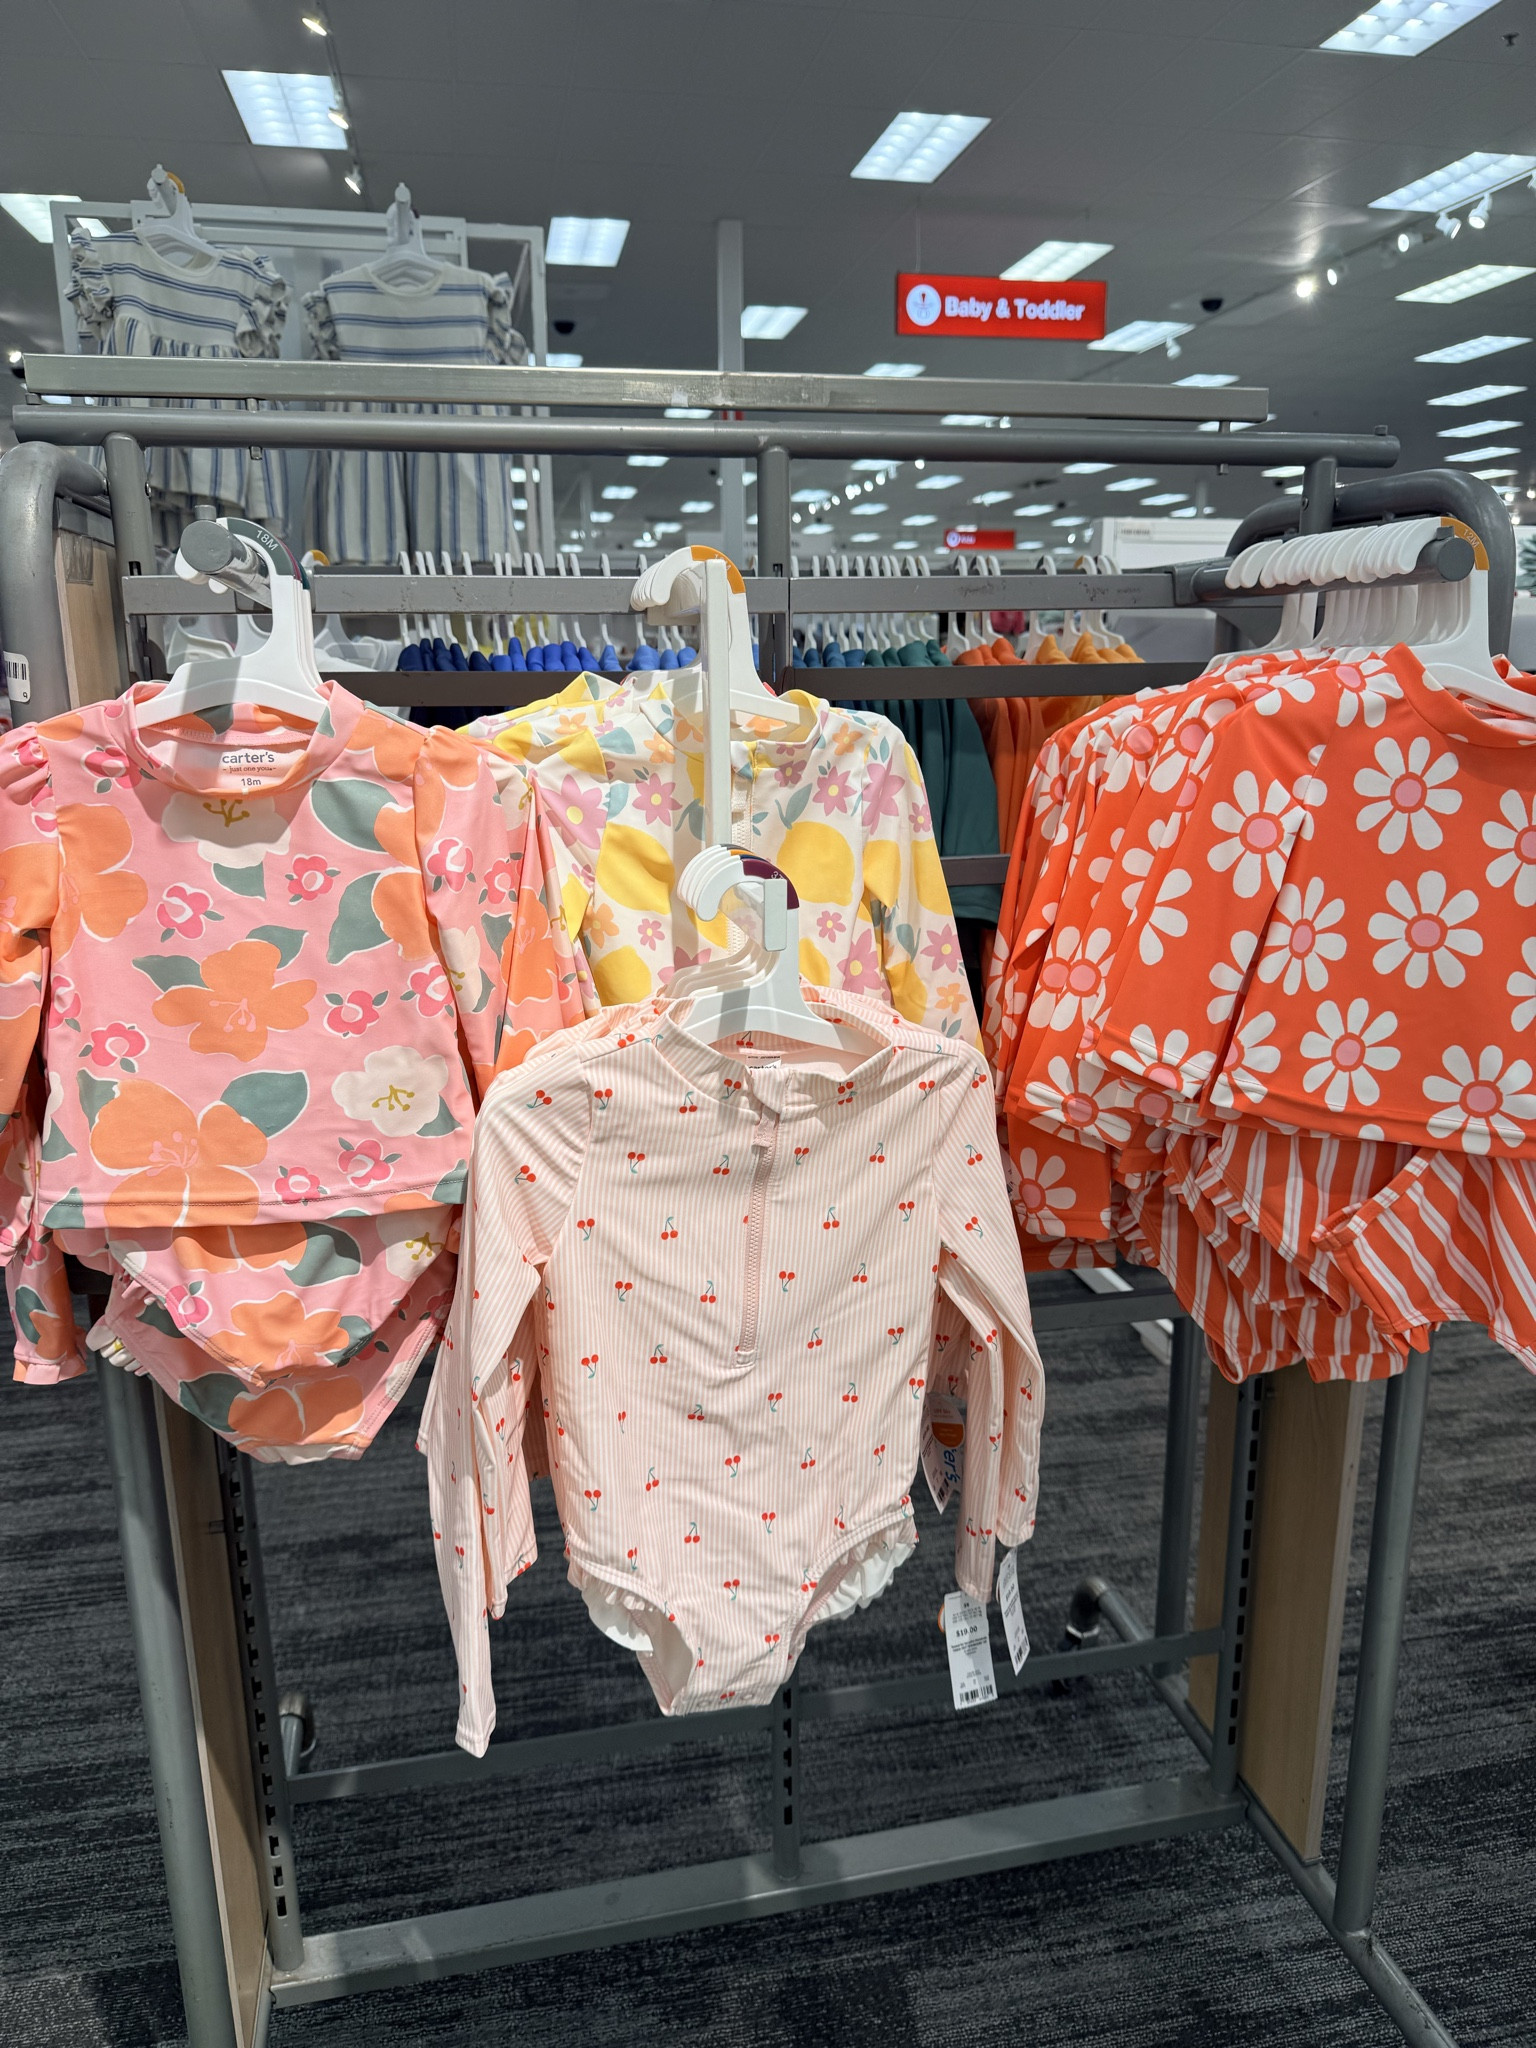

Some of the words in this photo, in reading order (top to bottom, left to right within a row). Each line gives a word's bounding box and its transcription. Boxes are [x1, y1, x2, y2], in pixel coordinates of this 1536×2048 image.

[945, 295, 992, 322] Baby
[996, 298, 1010, 319] &
[1014, 298, 1085, 321] Toddler
[256, 529, 279, 551] 18M
[1464, 528, 1480, 548] 12M
[222, 752, 275, 764] carter's
[229, 765, 242, 774] just
[241, 778, 261, 786] 18m
[943, 1449, 960, 1483] er's
